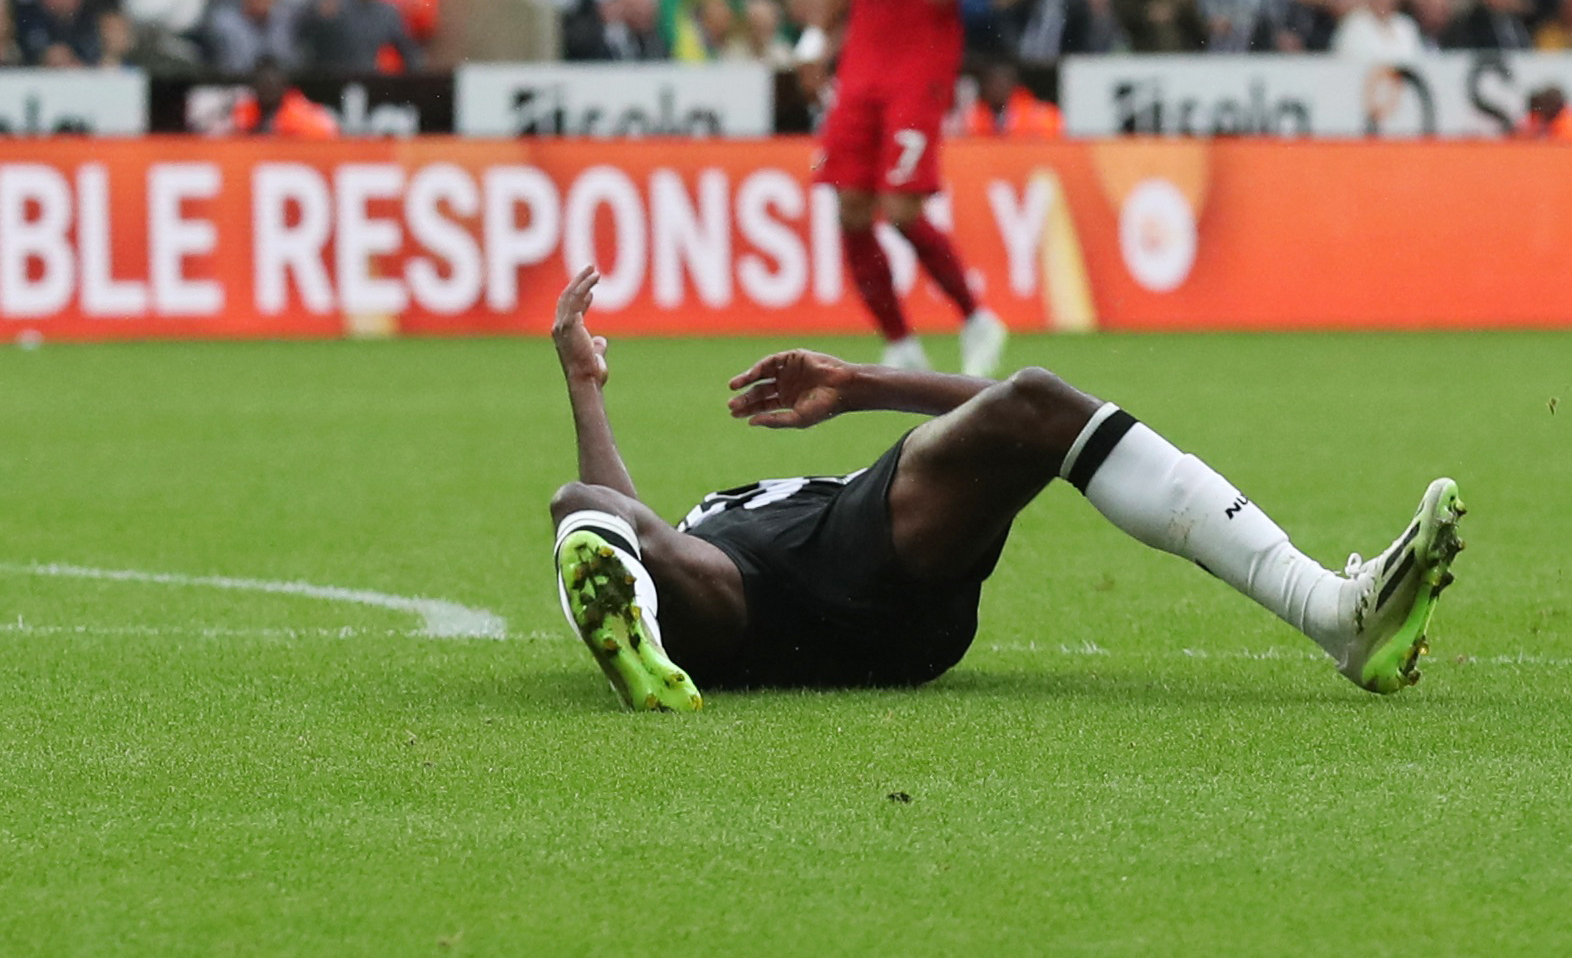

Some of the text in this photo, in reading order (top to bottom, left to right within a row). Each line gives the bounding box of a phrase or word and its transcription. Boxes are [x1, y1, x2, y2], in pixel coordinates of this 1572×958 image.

[886, 129, 928, 186] 7
[0, 162, 1055, 317] BLE RESPONSIY
